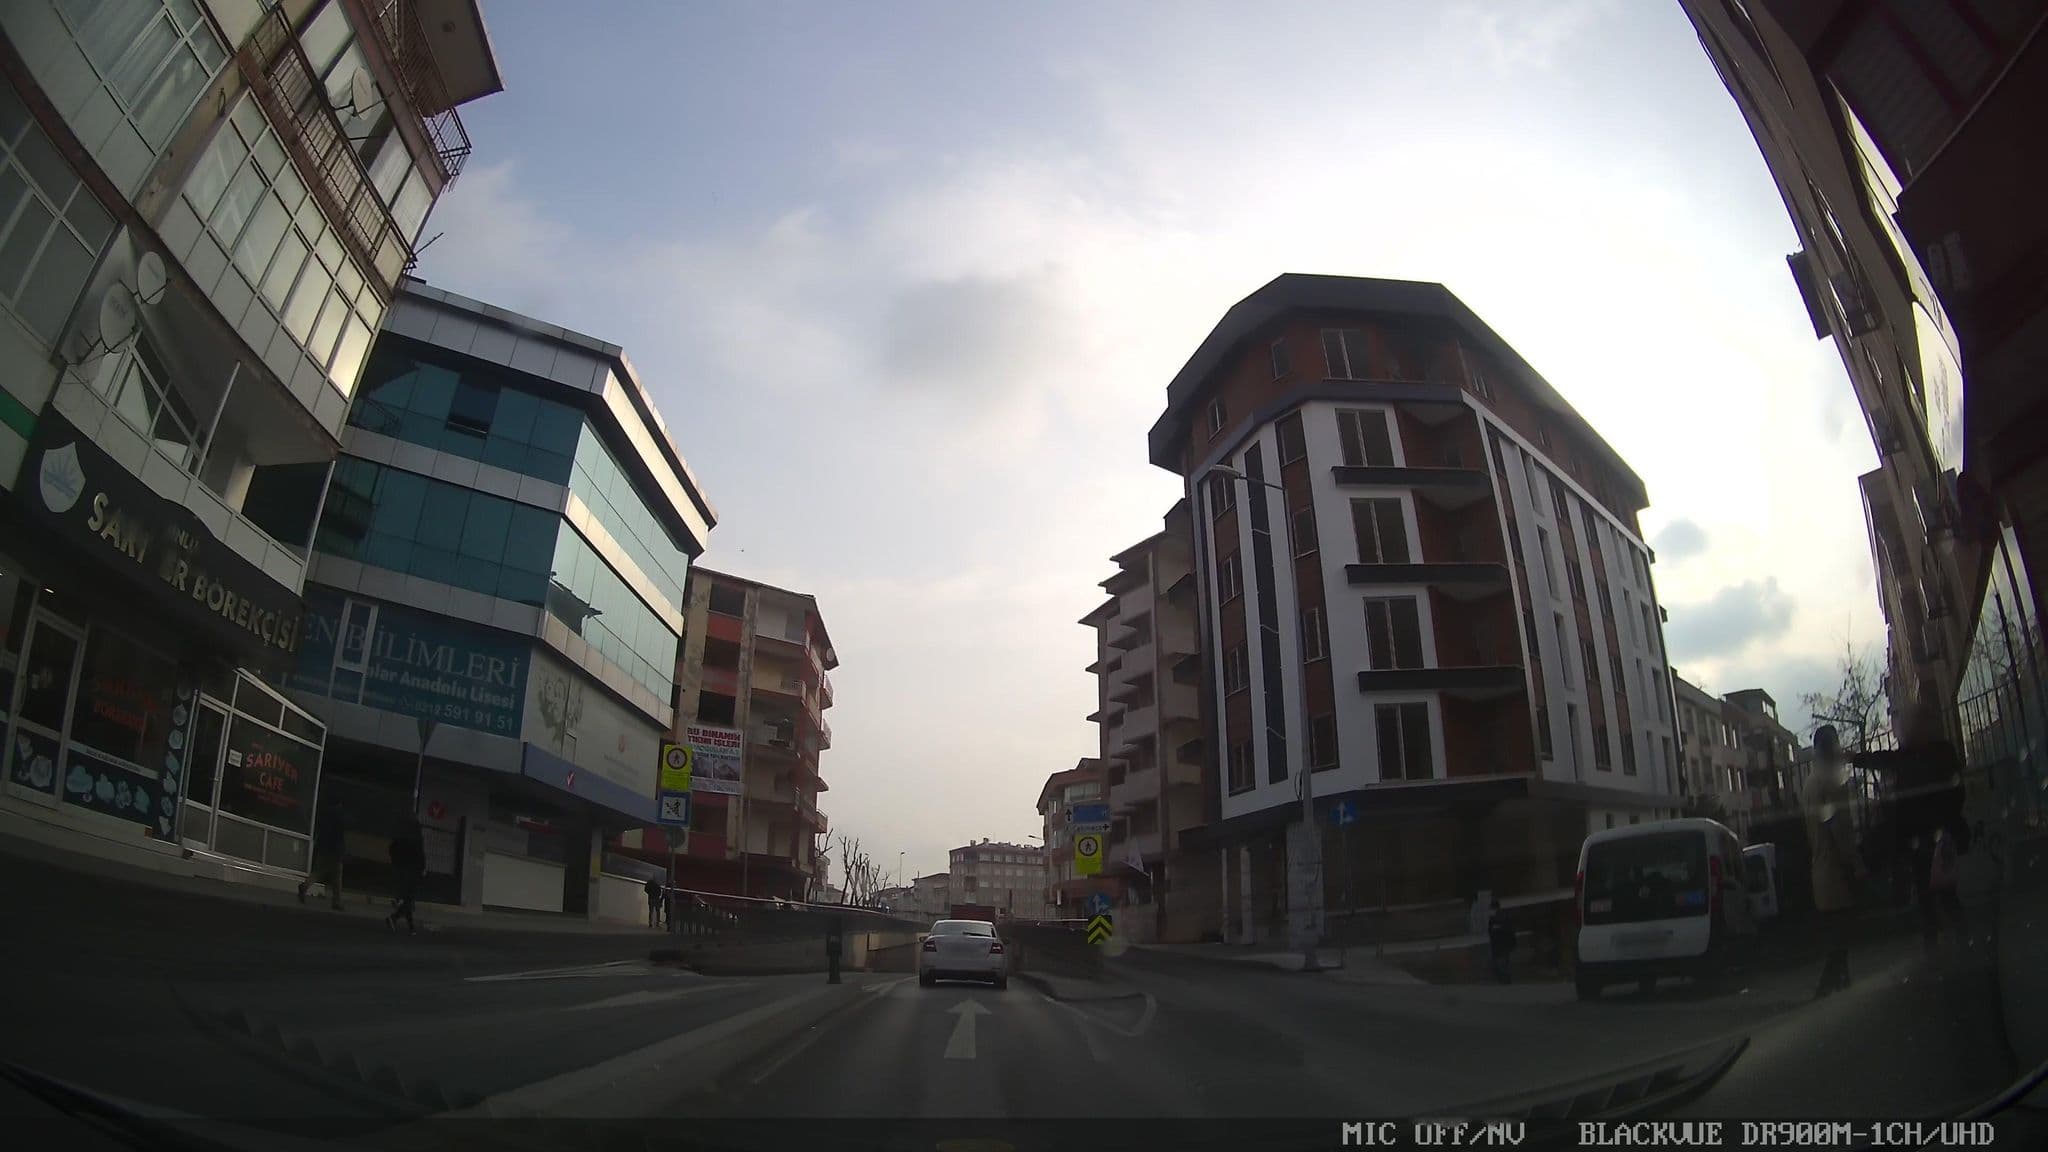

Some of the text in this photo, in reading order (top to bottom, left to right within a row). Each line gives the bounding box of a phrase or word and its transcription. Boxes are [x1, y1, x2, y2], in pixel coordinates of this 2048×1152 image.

[400, 671, 467, 700] Anadolu
[470, 685, 515, 710] Lisesi
[444, 704, 469, 720] 591
[475, 711, 491, 728] 91
[497, 715, 513, 731] 51
